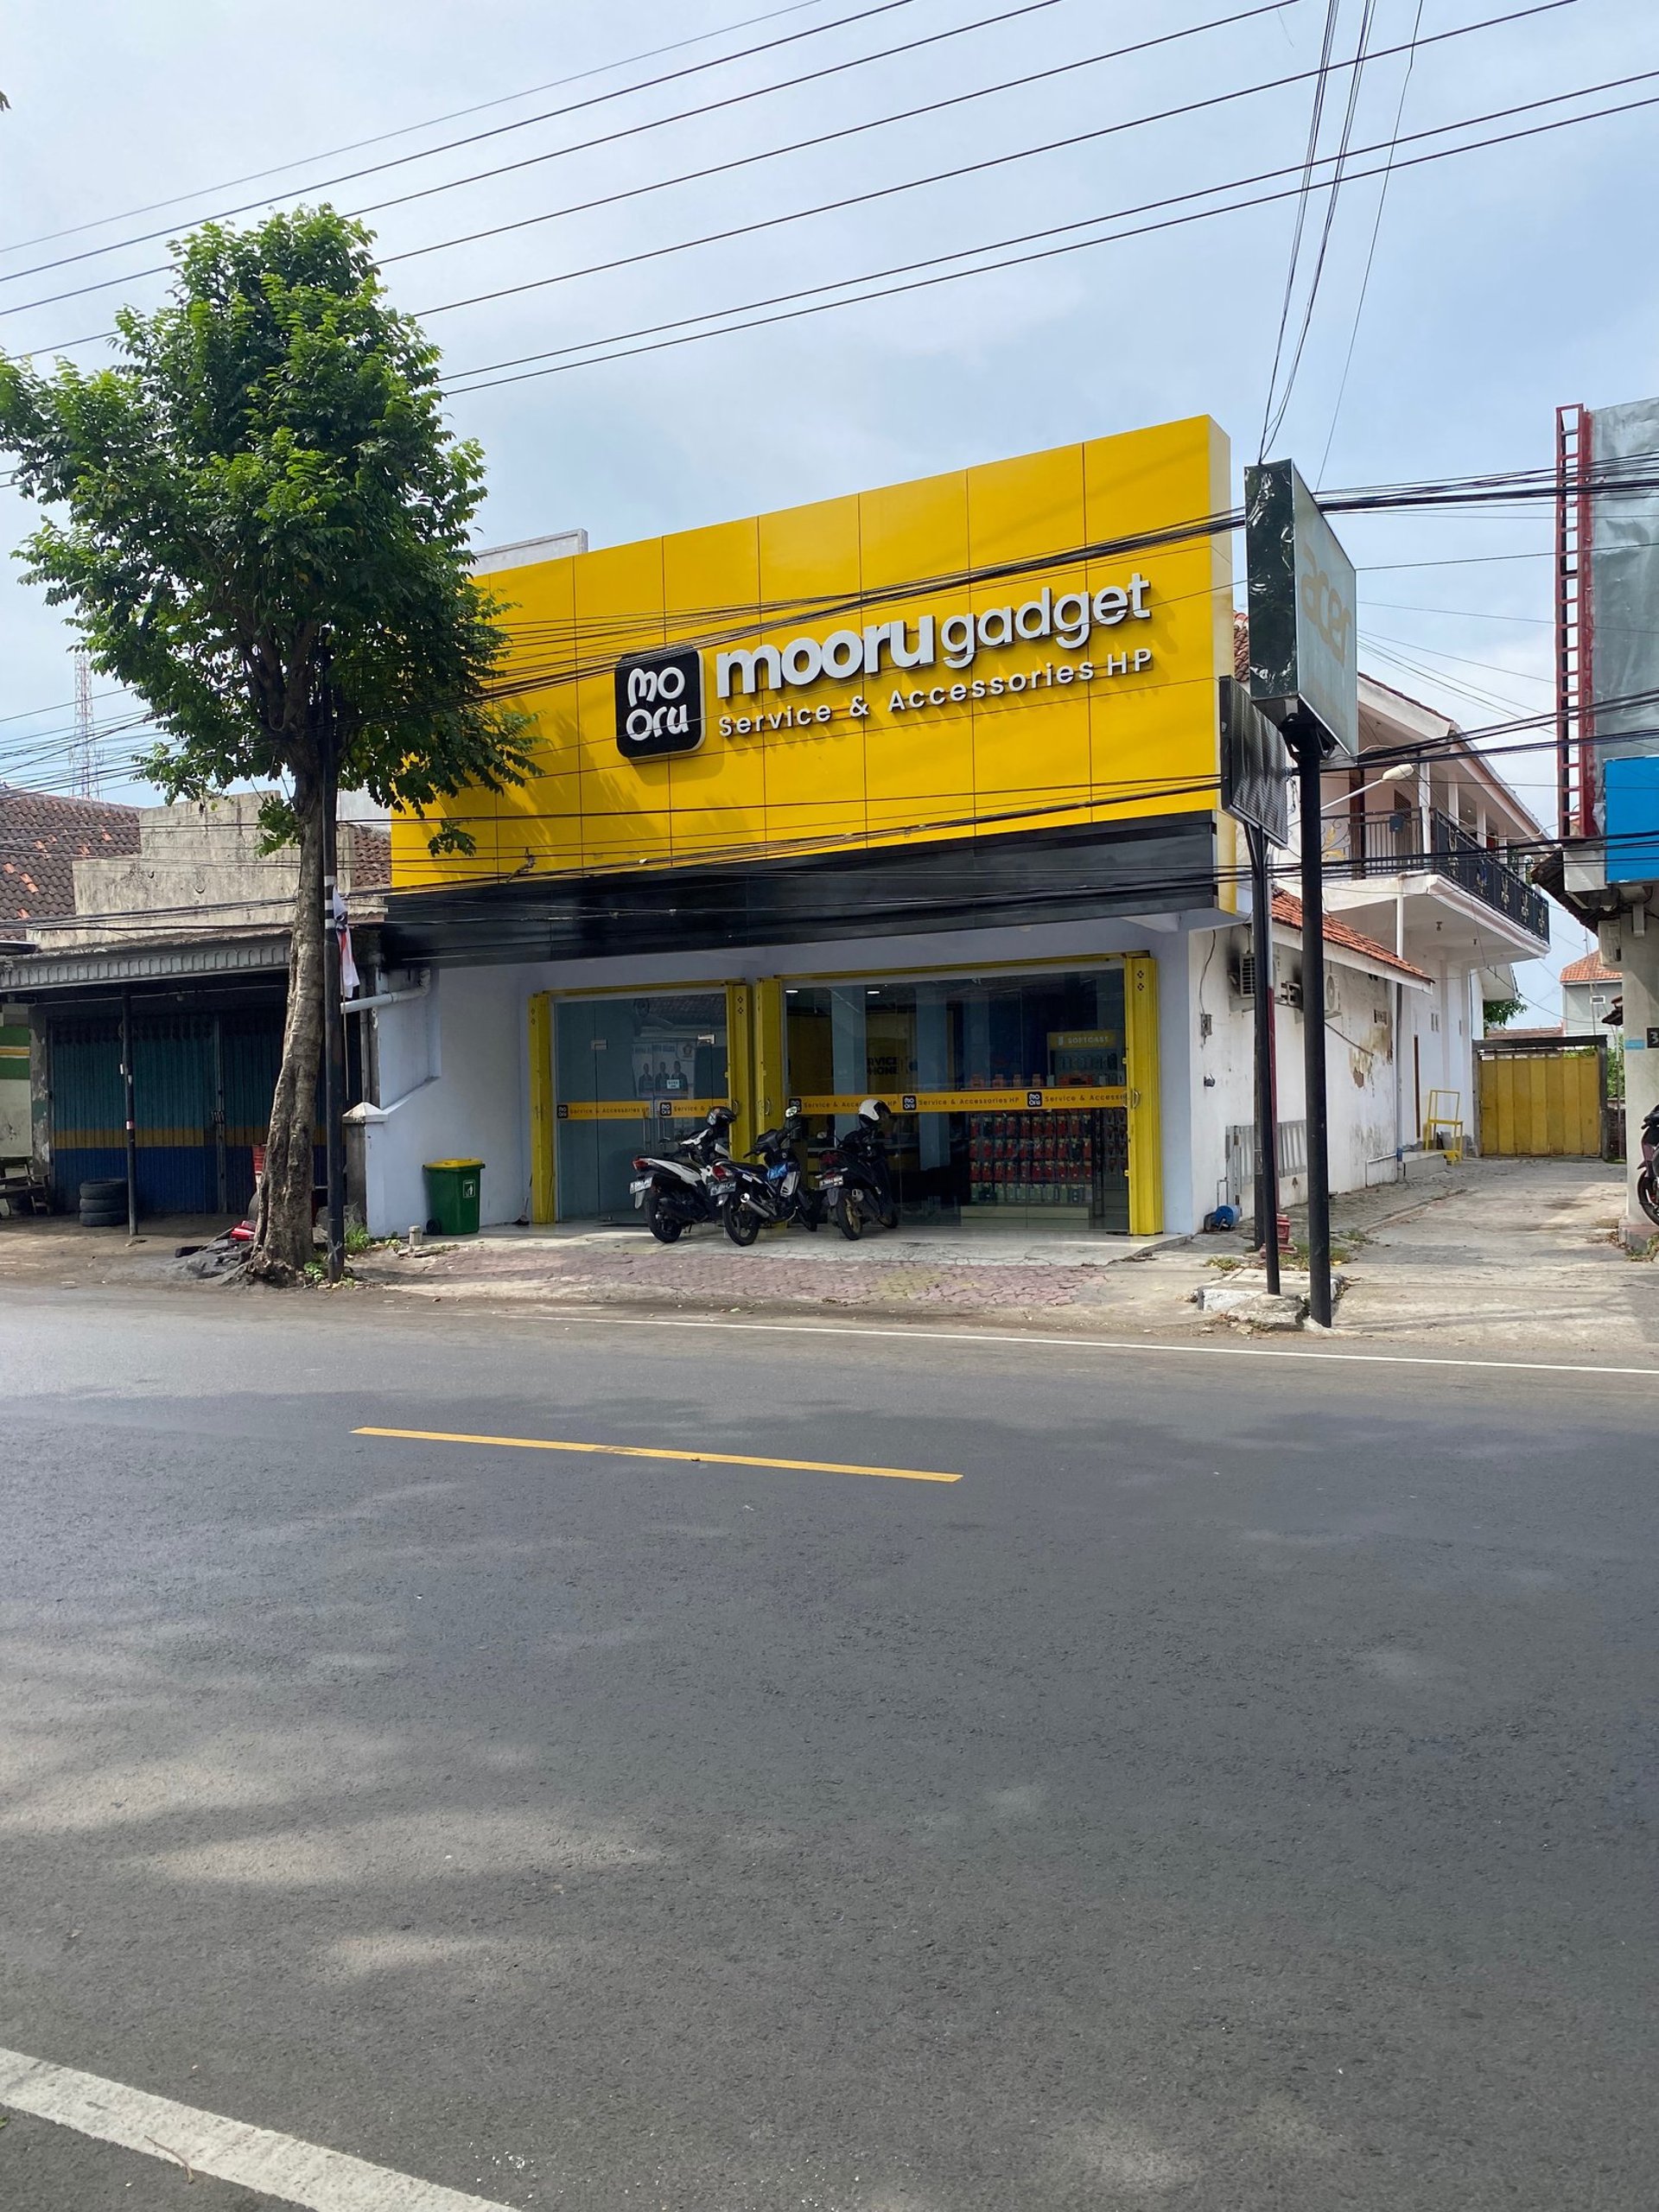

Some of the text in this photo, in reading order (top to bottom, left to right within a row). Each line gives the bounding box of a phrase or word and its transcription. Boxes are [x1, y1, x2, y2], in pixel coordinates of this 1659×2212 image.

[1301, 542, 1352, 667] acer
[719, 648, 1152, 738] Service & Accessories HP
